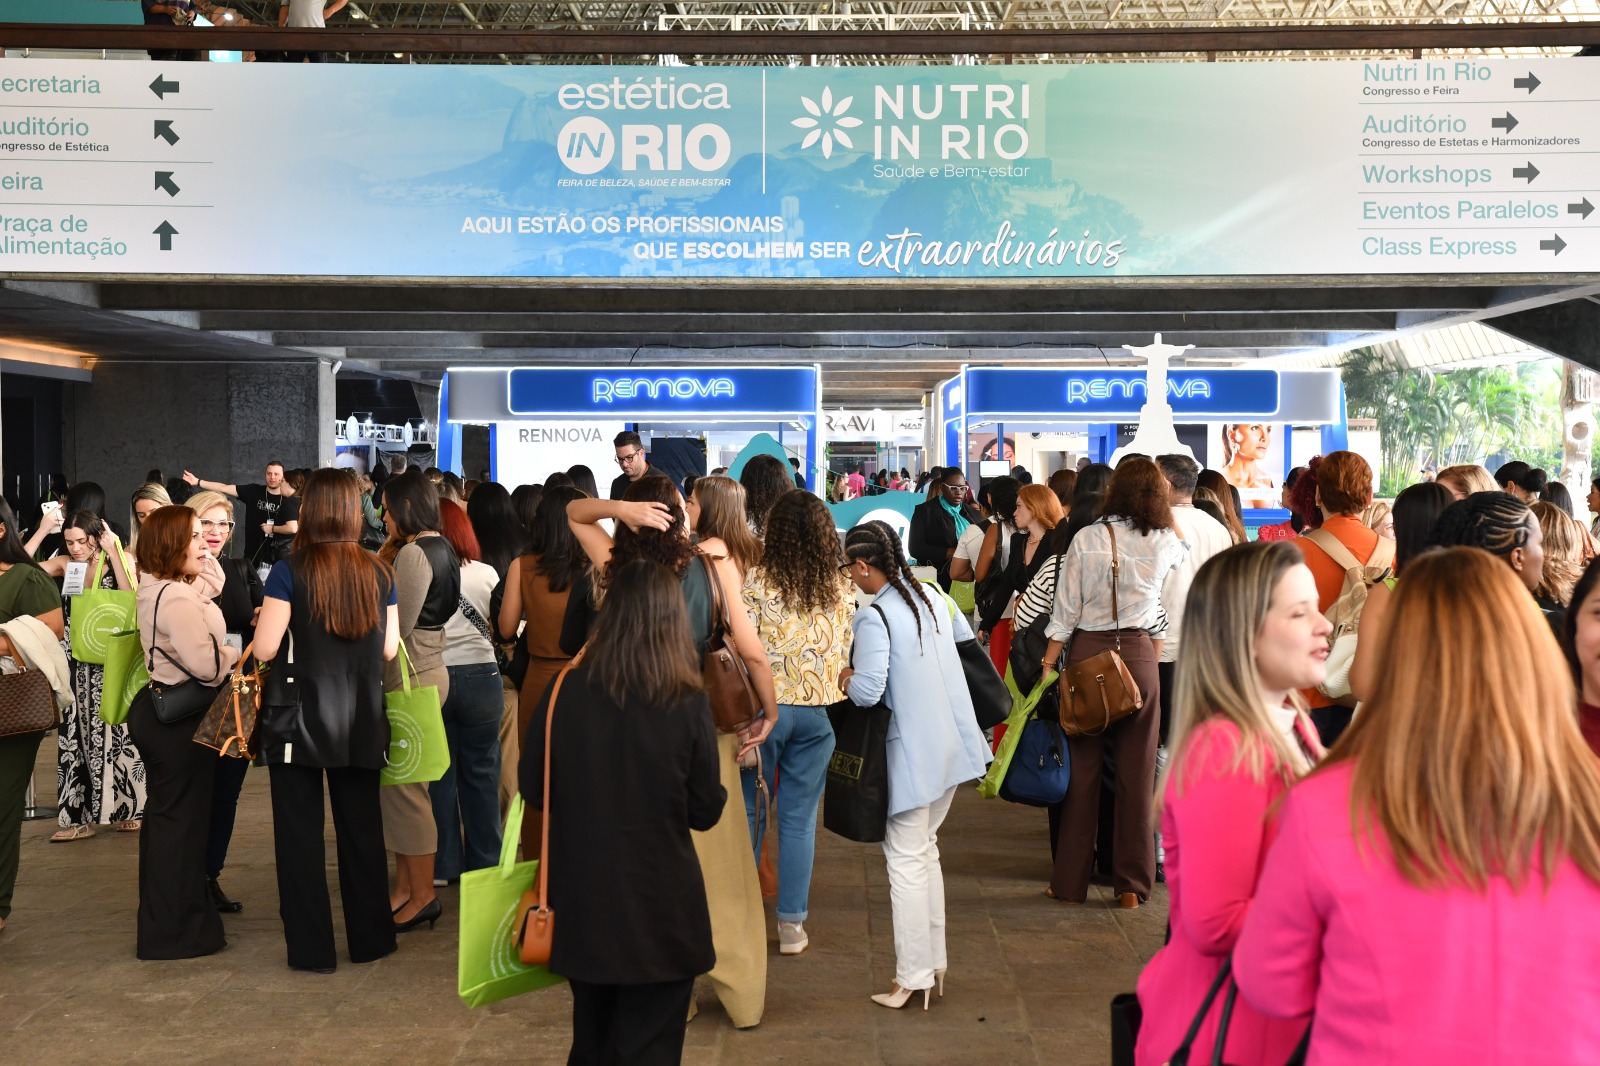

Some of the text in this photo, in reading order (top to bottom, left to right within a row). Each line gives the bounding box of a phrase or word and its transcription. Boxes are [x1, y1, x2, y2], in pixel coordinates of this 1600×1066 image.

[1364, 62, 1491, 82] Nutri In Rio
[1, 75, 101, 94] ecretaria
[557, 76, 731, 110] estética
[1362, 86, 1421, 97] Congresso
[1432, 86, 1460, 95] Feira
[874, 84, 1030, 120] NUTRI
[0, 116, 89, 137] uditório
[1362, 114, 1467, 134] Auditório
[0, 142, 109, 152] ngresso de Estética
[566, 123, 732, 172] IN RIO
[874, 123, 1029, 160] IN RIO
[1362, 138, 1420, 149] Congresso
[1422, 138, 1436, 147] de
[1439, 137, 1479, 147] Estetas
[1491, 136, 1581, 146] Harmonizadores
[873, 163, 1030, 178] Saúde e Bem-estar
[1362, 165, 1493, 187] Workshops
[1, 172, 43, 191] eira
[557, 177, 731, 188] FEIRA DE BELEZA, SAÚDE E BEM-ESTAR
[1363, 200, 1559, 220] Eventos Paralelos
[60, 214, 88, 232] de
[461, 212, 783, 234] AQUI ESTÃO OS PROFISSIONAIS
[634, 220, 1127, 273] QUE ESCOLHEM SER extraordinários
[1362, 237, 1517, 259] Class Express
[593, 378, 735, 402] RENNOVA
[1068, 378, 1211, 403] RENNVA
[518, 428, 603, 443] RENNOVA
